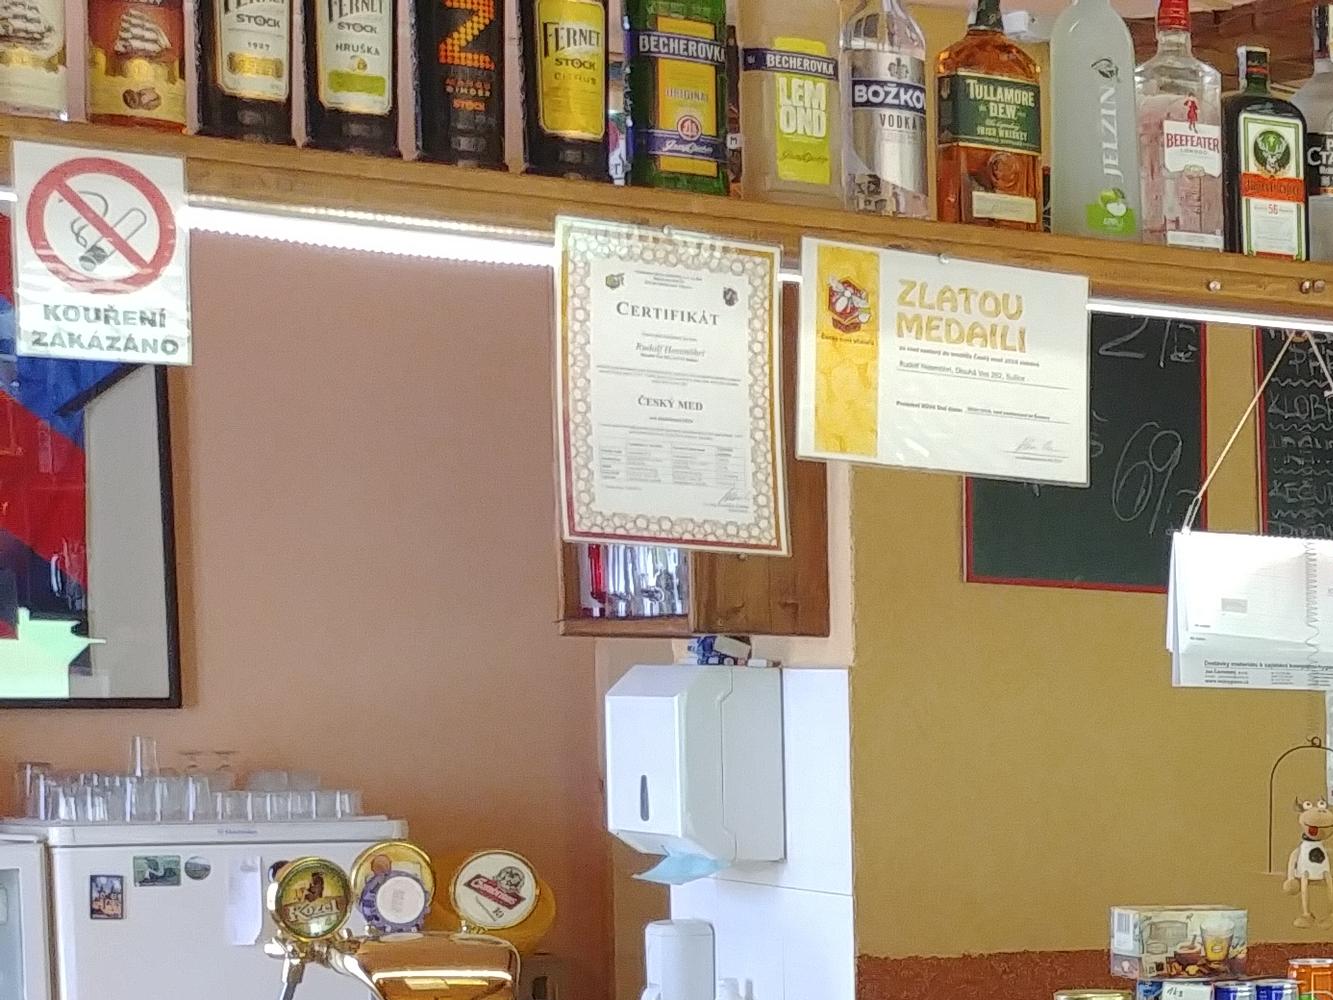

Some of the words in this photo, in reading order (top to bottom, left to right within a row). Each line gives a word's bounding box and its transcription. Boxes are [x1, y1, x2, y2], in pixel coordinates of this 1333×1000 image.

[236, 14, 281, 28] STOCK
[337, 21, 378, 34] STOCK
[335, 42, 381, 56] HRUŠKA
[543, 22, 601, 58] FERNET
[554, 58, 596, 71] STOCK
[766, 53, 834, 76] BECHEROVKA
[854, 83, 925, 111] BOŽKO
[965, 79, 1035, 106] TULLAMORE
[879, 113, 918, 131] VODKA
[1101, 86, 1124, 183] JELZIN
[1166, 132, 1220, 154] BEEFEATER
[898, 279, 1024, 321] ZLATOU
[43, 303, 167, 328] KOUŘENÍ
[616, 301, 720, 326] CERTIFIKÁT
[31, 329, 179, 356] ZAKÁZÁNO
[896, 312, 1027, 354] MEDAILI
[637, 394, 675, 409] ČESKÝ
[677, 399, 704, 412] MED
